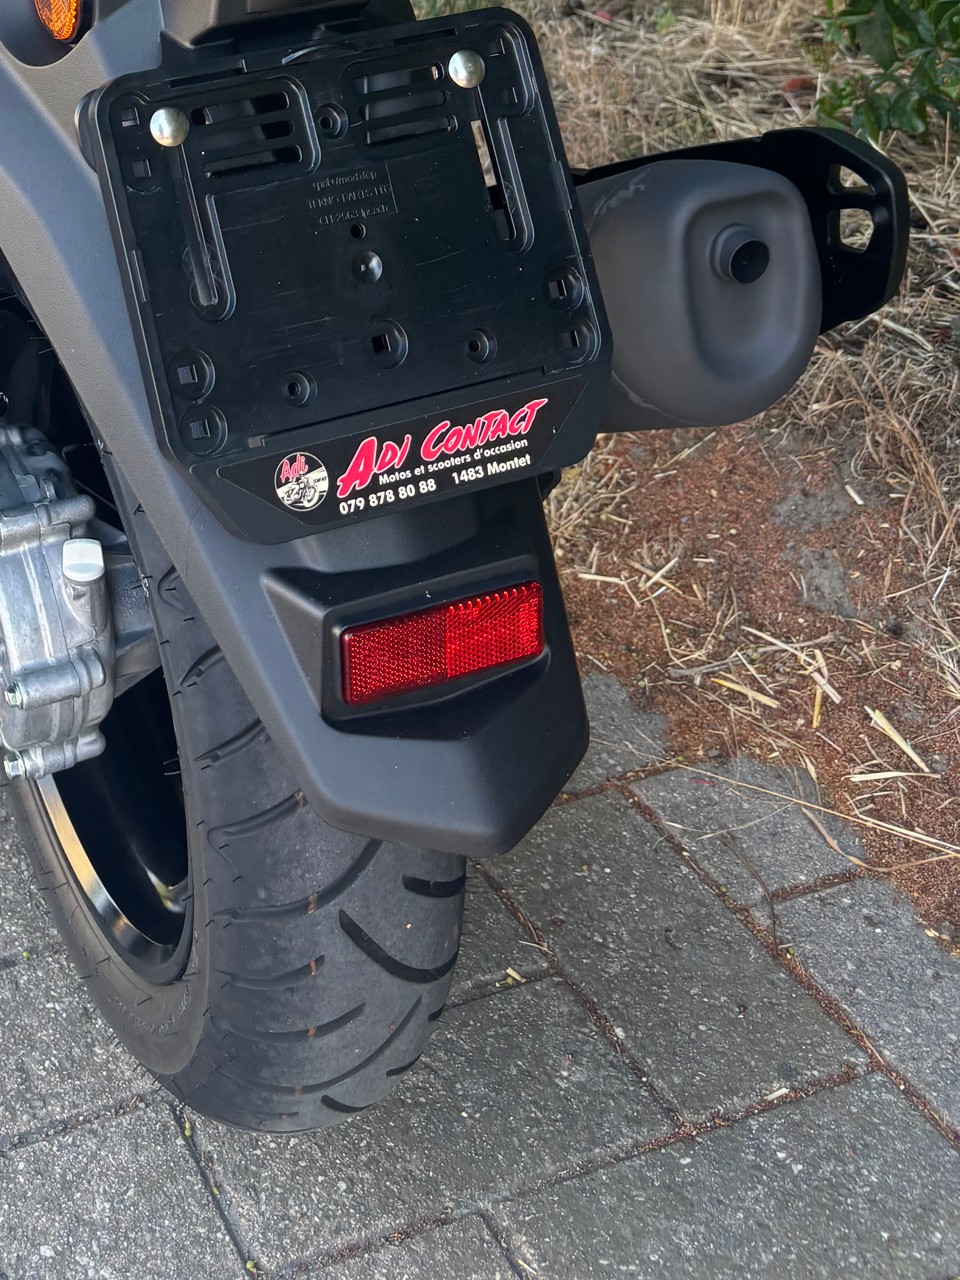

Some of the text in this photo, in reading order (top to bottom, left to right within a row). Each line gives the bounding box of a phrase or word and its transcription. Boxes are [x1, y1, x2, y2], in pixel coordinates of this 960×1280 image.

[421, 398, 549, 461] CONTACT
[280, 453, 309, 483] Adi
[339, 453, 531, 515] 079 878 80 88 1483 Montet
[379, 439, 529, 485] Motos et scooters d'occasion
